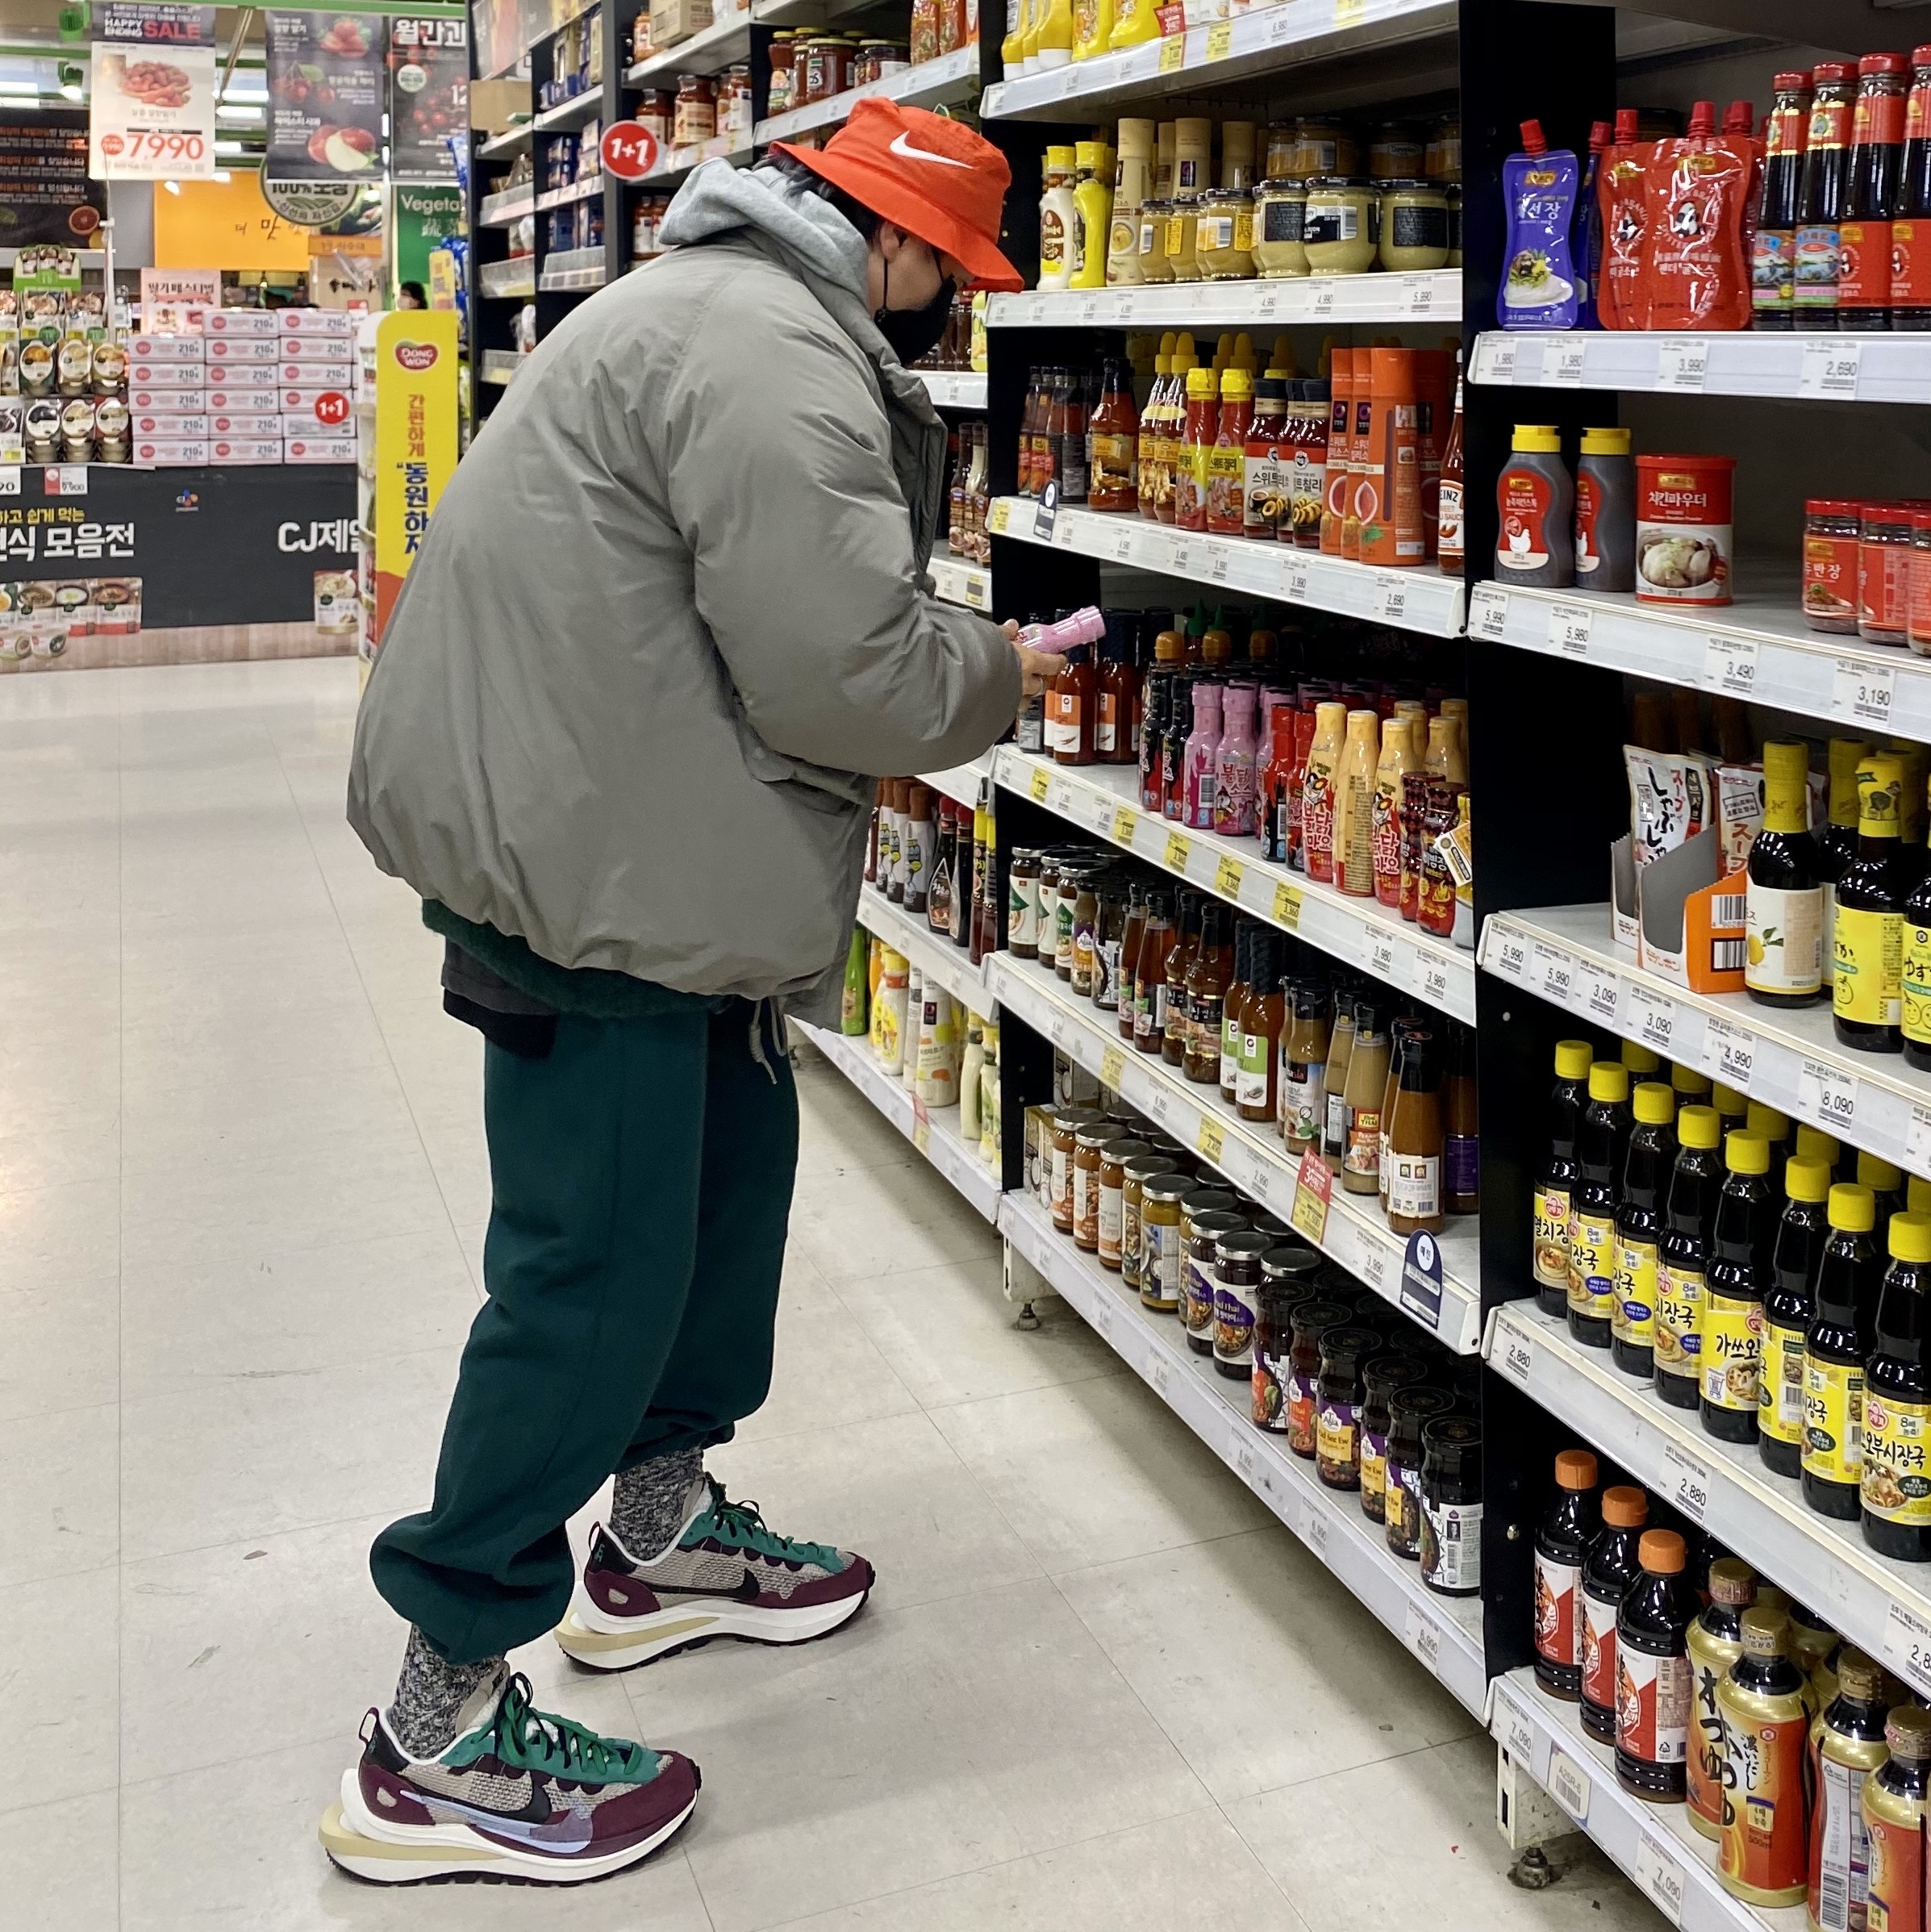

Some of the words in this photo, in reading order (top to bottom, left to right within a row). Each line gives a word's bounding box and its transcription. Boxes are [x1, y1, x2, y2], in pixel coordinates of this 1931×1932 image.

[105, 19, 142, 27] HAPPY
[144, 19, 201, 38] SALE
[610, 137, 649, 166] 1+1
[405, 357, 431, 367] WON
[319, 398, 344, 417] 1+1
[407, 394, 425, 457] 간편하게
[1649, 490, 1708, 508] 치킨파우더
[44, 522, 135, 560] 모음전
[1858, 686, 1891, 707] 3,190
[1502, 944, 1524, 964] 5,990
[1547, 967, 1570, 987] 5,990
[1593, 984, 1617, 1006] 3,090
[1646, 1012, 1672, 1035] 3,090
[1725, 1047, 1753, 1070] 4,990
[1823, 1091, 1854, 1115] 8,090
[1360, 1118, 1378, 1127] THAI
[1570, 1243, 1599, 1272] 장국
[1509, 1343, 1531, 1368] 2,880
[1338, 1435, 1349, 1445] Ew
[1680, 1477, 1707, 1507] 2,880
[1512, 1720, 1532, 1750] 7,090
[1658, 1867, 1681, 1901] 7,090
